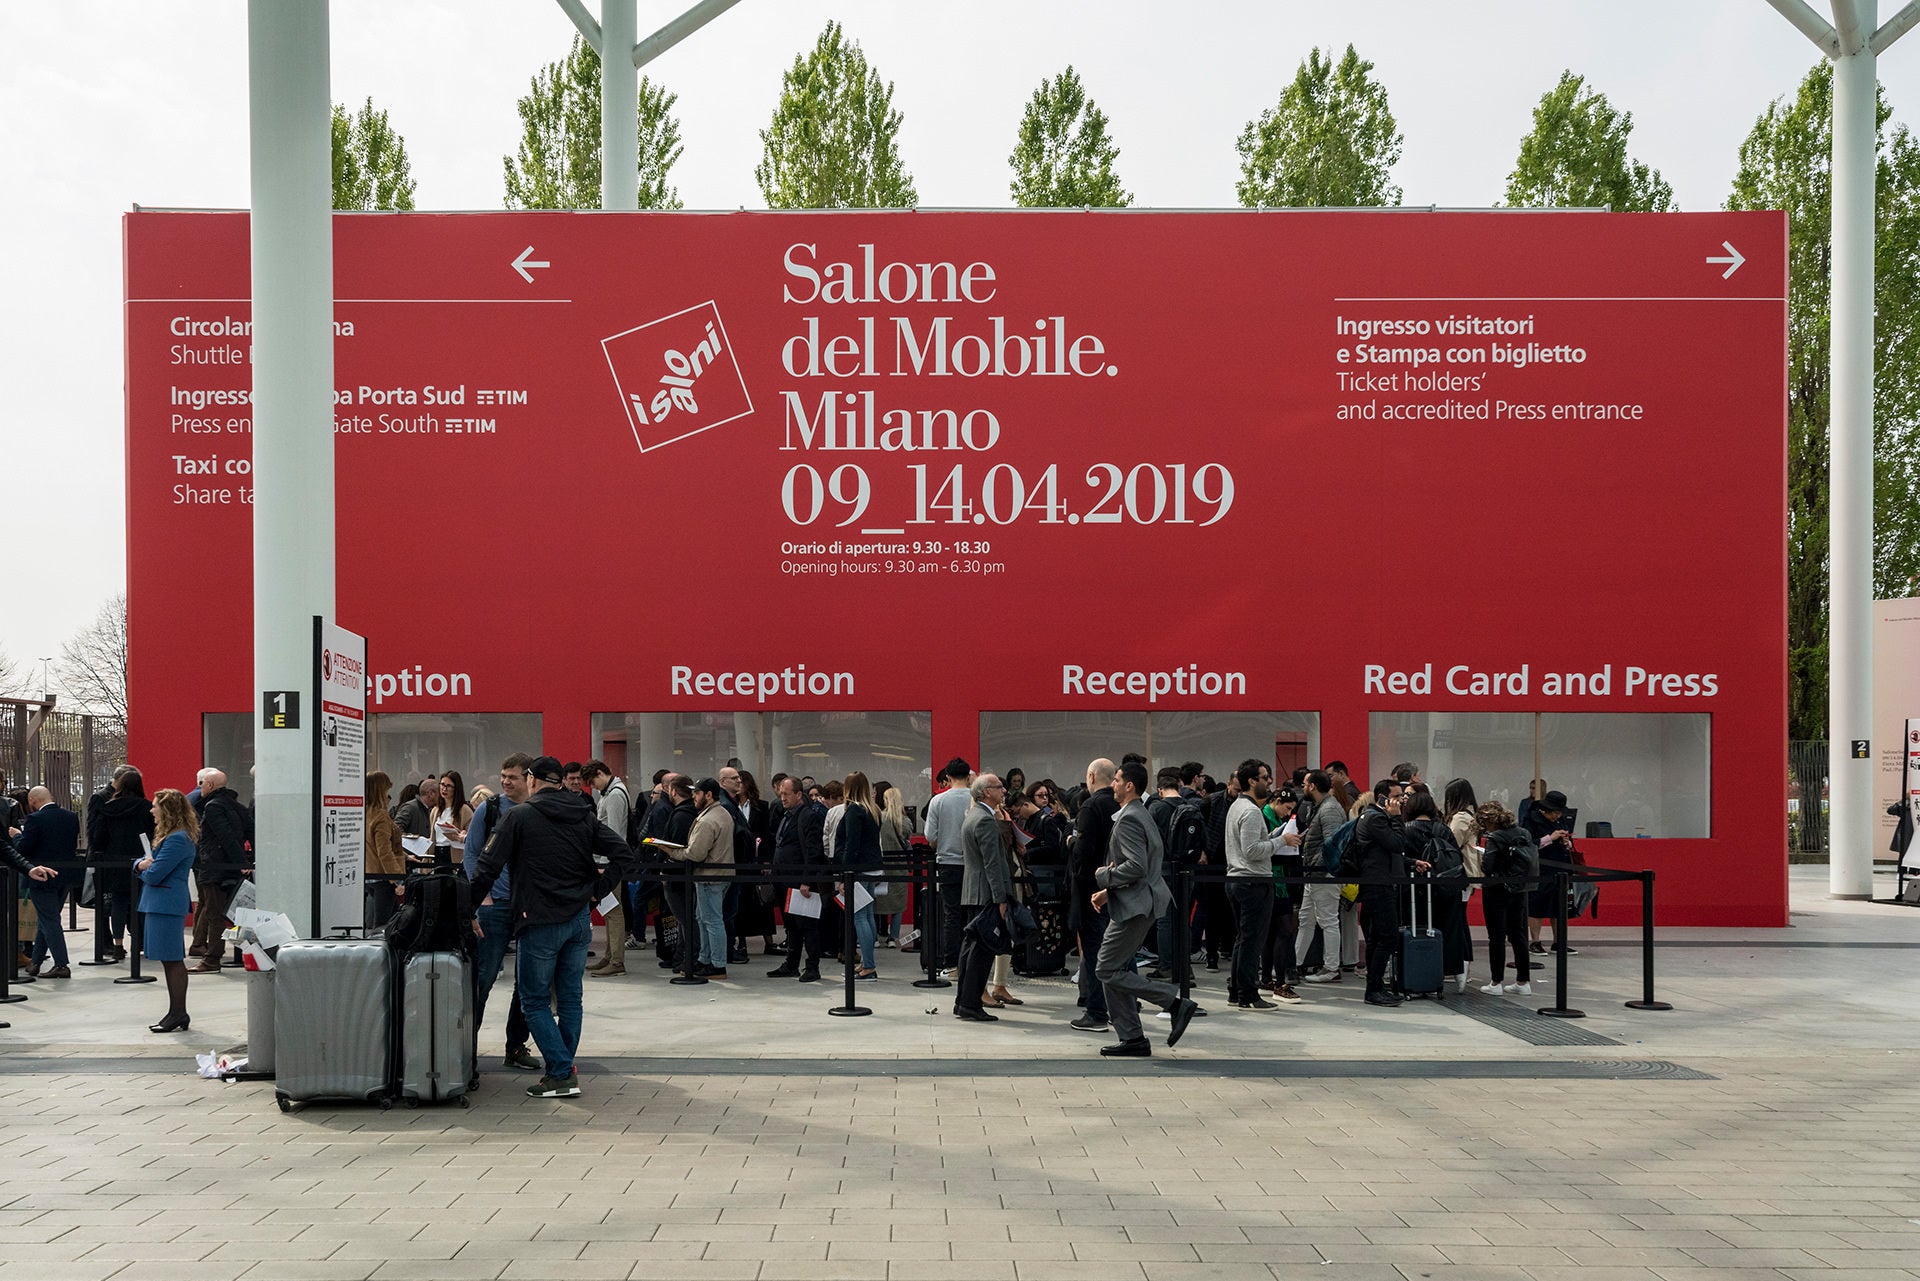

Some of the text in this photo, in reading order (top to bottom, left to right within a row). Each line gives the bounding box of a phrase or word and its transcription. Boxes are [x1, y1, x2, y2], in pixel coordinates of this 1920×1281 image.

[783, 242, 997, 305] Salone
[170, 315, 251, 337] Circolar
[1336, 314, 1534, 341] Ingresso visitatori
[170, 344, 243, 365] Shuttle
[781, 316, 1119, 378] del Mobile.
[1336, 343, 1587, 369] e Stampa con biglietto
[1336, 371, 1399, 392] Ticket
[358, 385, 418, 406] Porta
[422, 384, 465, 406] Sud
[495, 390, 528, 405] TIM
[1336, 399, 1644, 420] and accredited Press entrance
[171, 414, 222, 434] Press
[226, 418, 252, 434] en
[378, 412, 439, 434] South
[464, 419, 496, 434] TIM
[779, 391, 1001, 451] Milano
[171, 455, 251, 475] Taxi co
[173, 484, 254, 505] Share ta
[781, 463, 1235, 535] 09_14.04.2019
[780, 541, 826, 555] Orario
[828, 540, 842, 554] di
[844, 542, 910, 558] apertura:
[912, 541, 942, 555] 9.30
[953, 541, 991, 555] 18.30
[780, 560, 838, 577] Opening
[840, 560, 881, 574] hours:
[884, 560, 915, 573] 9.30
[917, 562, 939, 573] am
[950, 560, 981, 573] 6.30
[983, 562, 1005, 576] pm
[367, 664, 472, 705] ption
[671, 663, 855, 704] Reception
[1062, 663, 1246, 703] Reception
[1364, 663, 1719, 697] Red Card and Press
[273, 693, 286, 714] 1
[274, 714, 286, 727] E
[1857, 741, 1867, 751] 2
